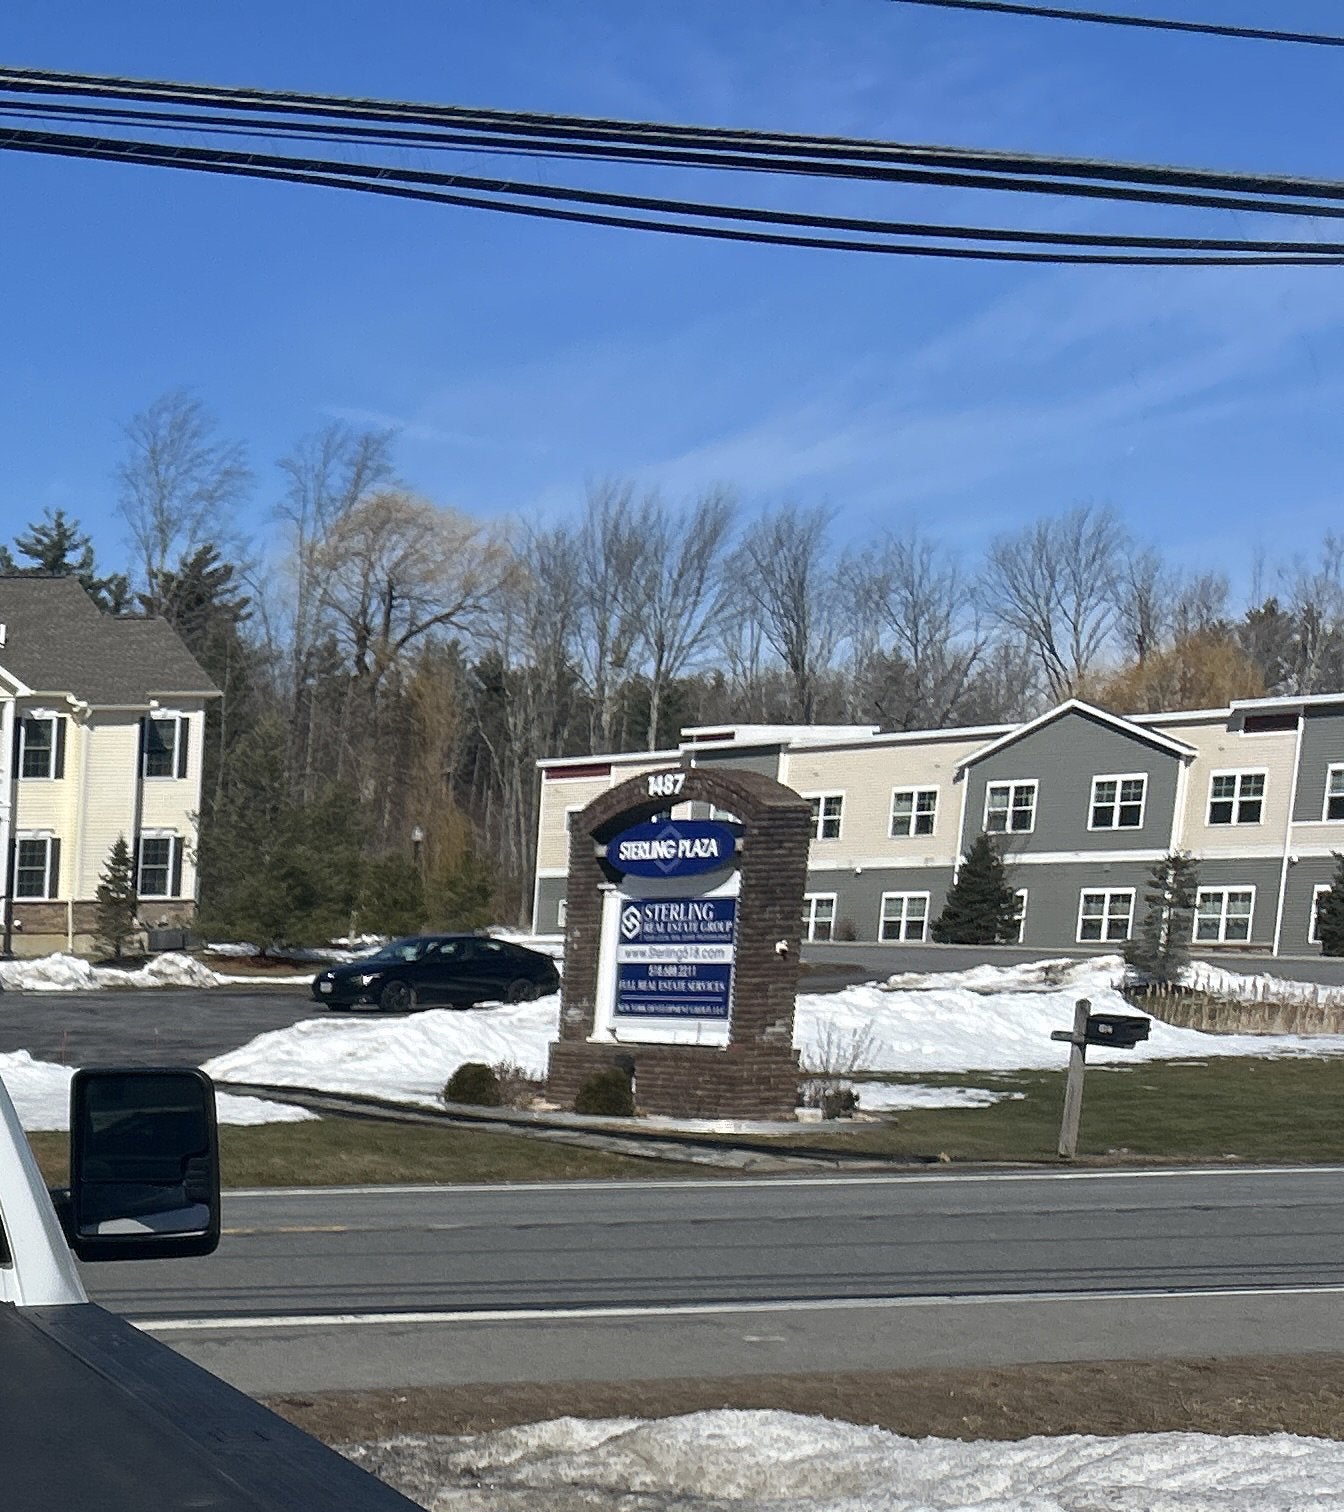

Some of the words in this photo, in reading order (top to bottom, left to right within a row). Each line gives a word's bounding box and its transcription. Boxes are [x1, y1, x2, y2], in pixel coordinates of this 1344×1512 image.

[648, 772, 686, 797] 1487
[619, 840, 677, 860] STERLING
[678, 838, 719, 859] PLAZA
[645, 902, 714, 921] STERLING
[644, 920, 665, 933] REAL
[667, 920, 699, 933] ESTATE
[700, 920, 733, 933] GROUP
